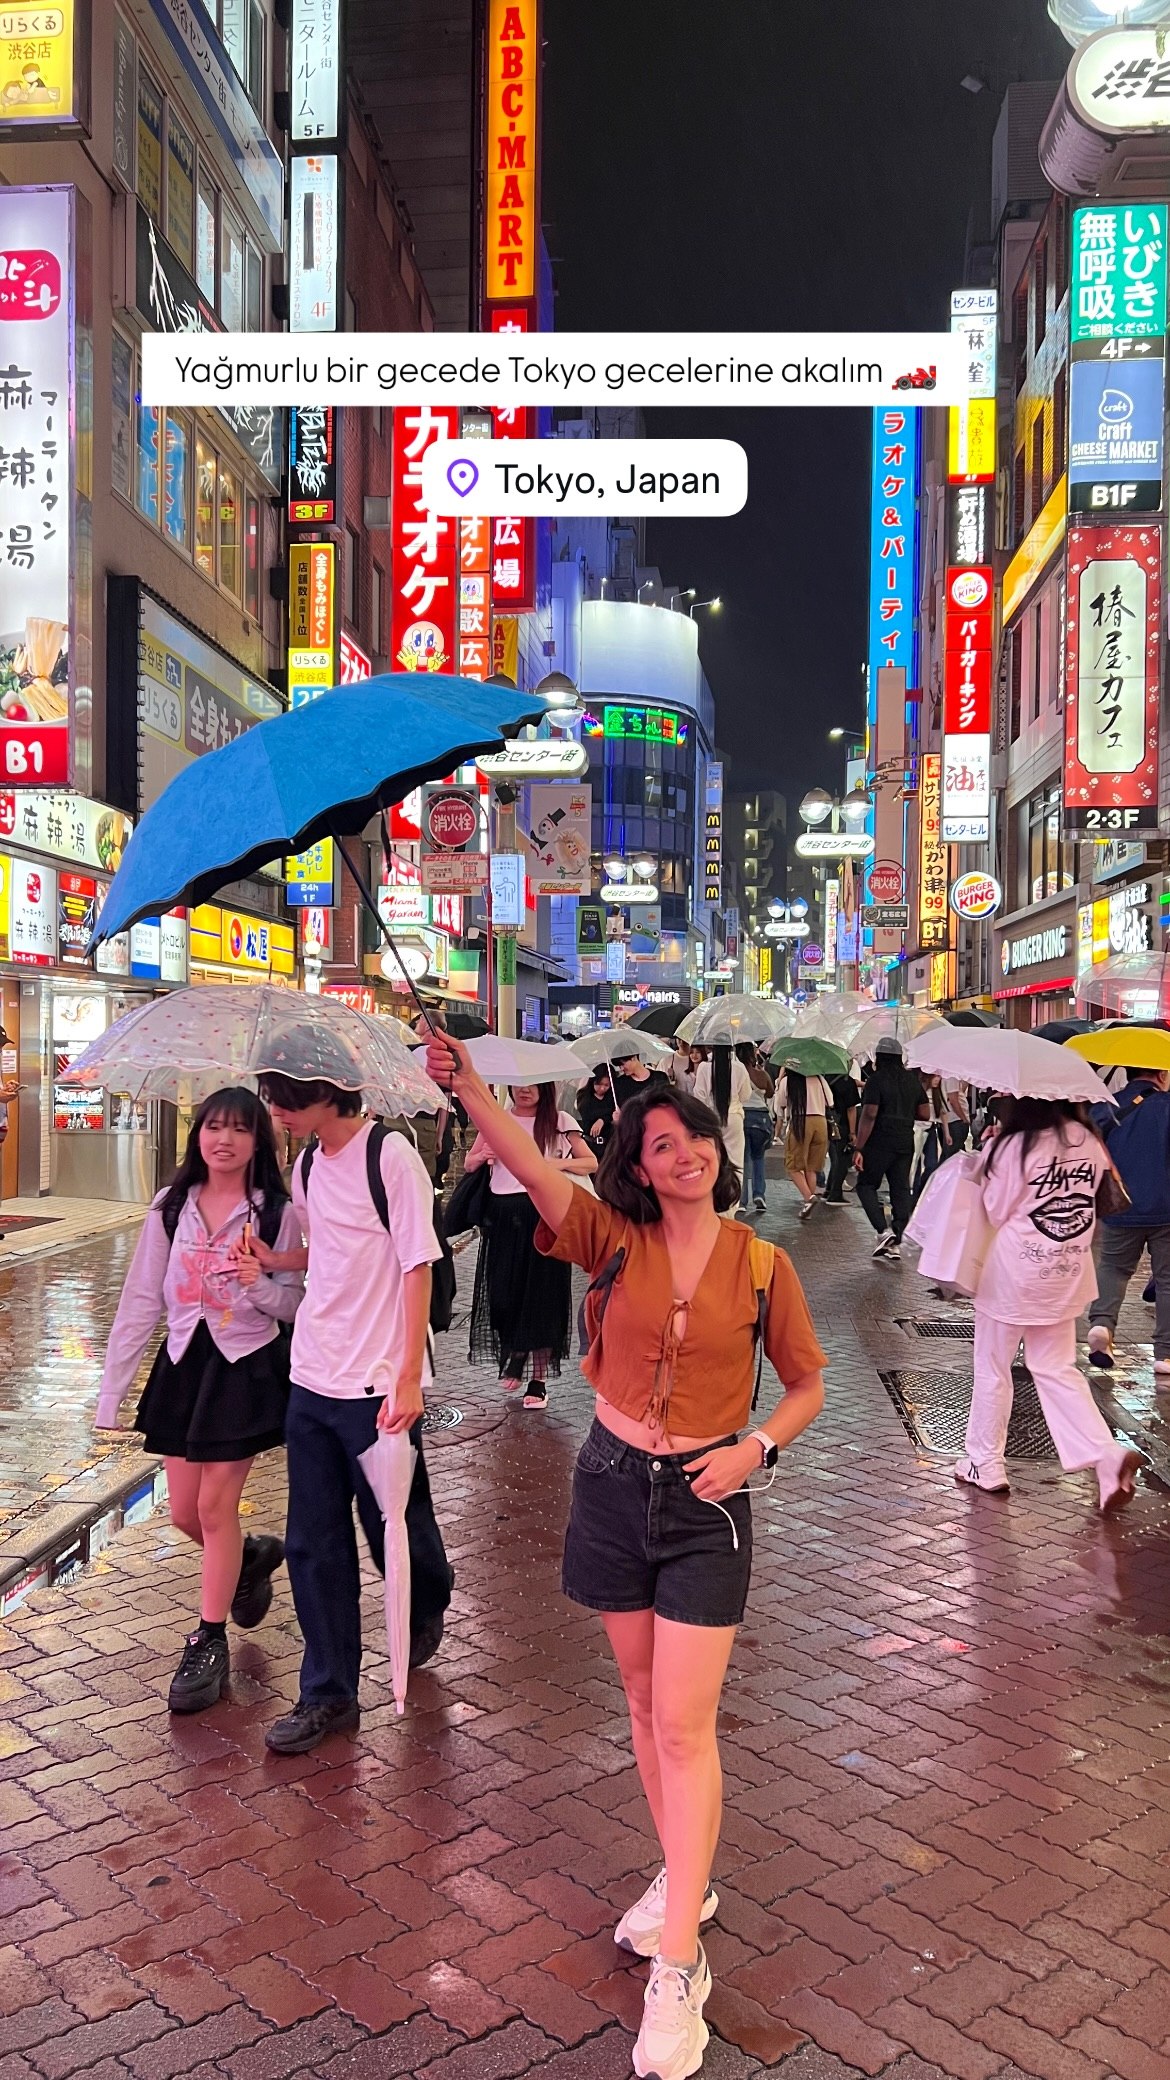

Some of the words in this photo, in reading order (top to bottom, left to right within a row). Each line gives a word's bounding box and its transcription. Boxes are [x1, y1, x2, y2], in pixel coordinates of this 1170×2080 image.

[3, 15, 57, 34] りらくる
[8, 41, 52, 60] 渋谷店
[498, 7, 526, 286] ABC-MART
[1079, 211, 1117, 320] 無呼吸
[1122, 210, 1163, 318] いびき
[310, 302, 332, 317] 4F
[952, 296, 995, 308] センタービル
[1078, 321, 1159, 337] ご相談ください
[1100, 338, 1133, 359] 4F
[1103, 401, 1128, 412] craft
[1098, 422, 1132, 441] Craft
[1072, 441, 1107, 456] CHEESE
[1109, 441, 1158, 459] MARKET
[41, 391, 58, 541] マーラータン
[1091, 484, 1137, 507] B1F
[295, 504, 328, 519] 3F
[314, 552, 328, 644] 全身もみほぐし
[959, 584, 982, 599] KING
[295, 655, 327, 665] りらくる
[1089, 584, 1137, 749] 椿屋カフェ
[295, 671, 327, 683] 渋谷店
[959, 619, 978, 729] バーガーキング
[5, 740, 43, 775] B1
[945, 765, 975, 792] 油
[924, 782, 936, 818] サワー
[23, 805, 86, 857] 麻辣湯
[433, 812, 473, 832] 消火栓
[945, 823, 987, 836] センタービル
[802, 839, 872, 850] 渋谷センター街
[315, 845, 323, 871] 牛めし
[924, 851, 945, 894] かわ串
[300, 883, 319, 892] 24h
[870, 876, 900, 890] 消火栓
[957, 882, 993, 899] BURGER
[959, 889, 995, 912] KING
[246, 925, 268, 961] 松屋
[1012, 933, 1043, 969] BURGER
[1043, 925, 1066, 961] KING
